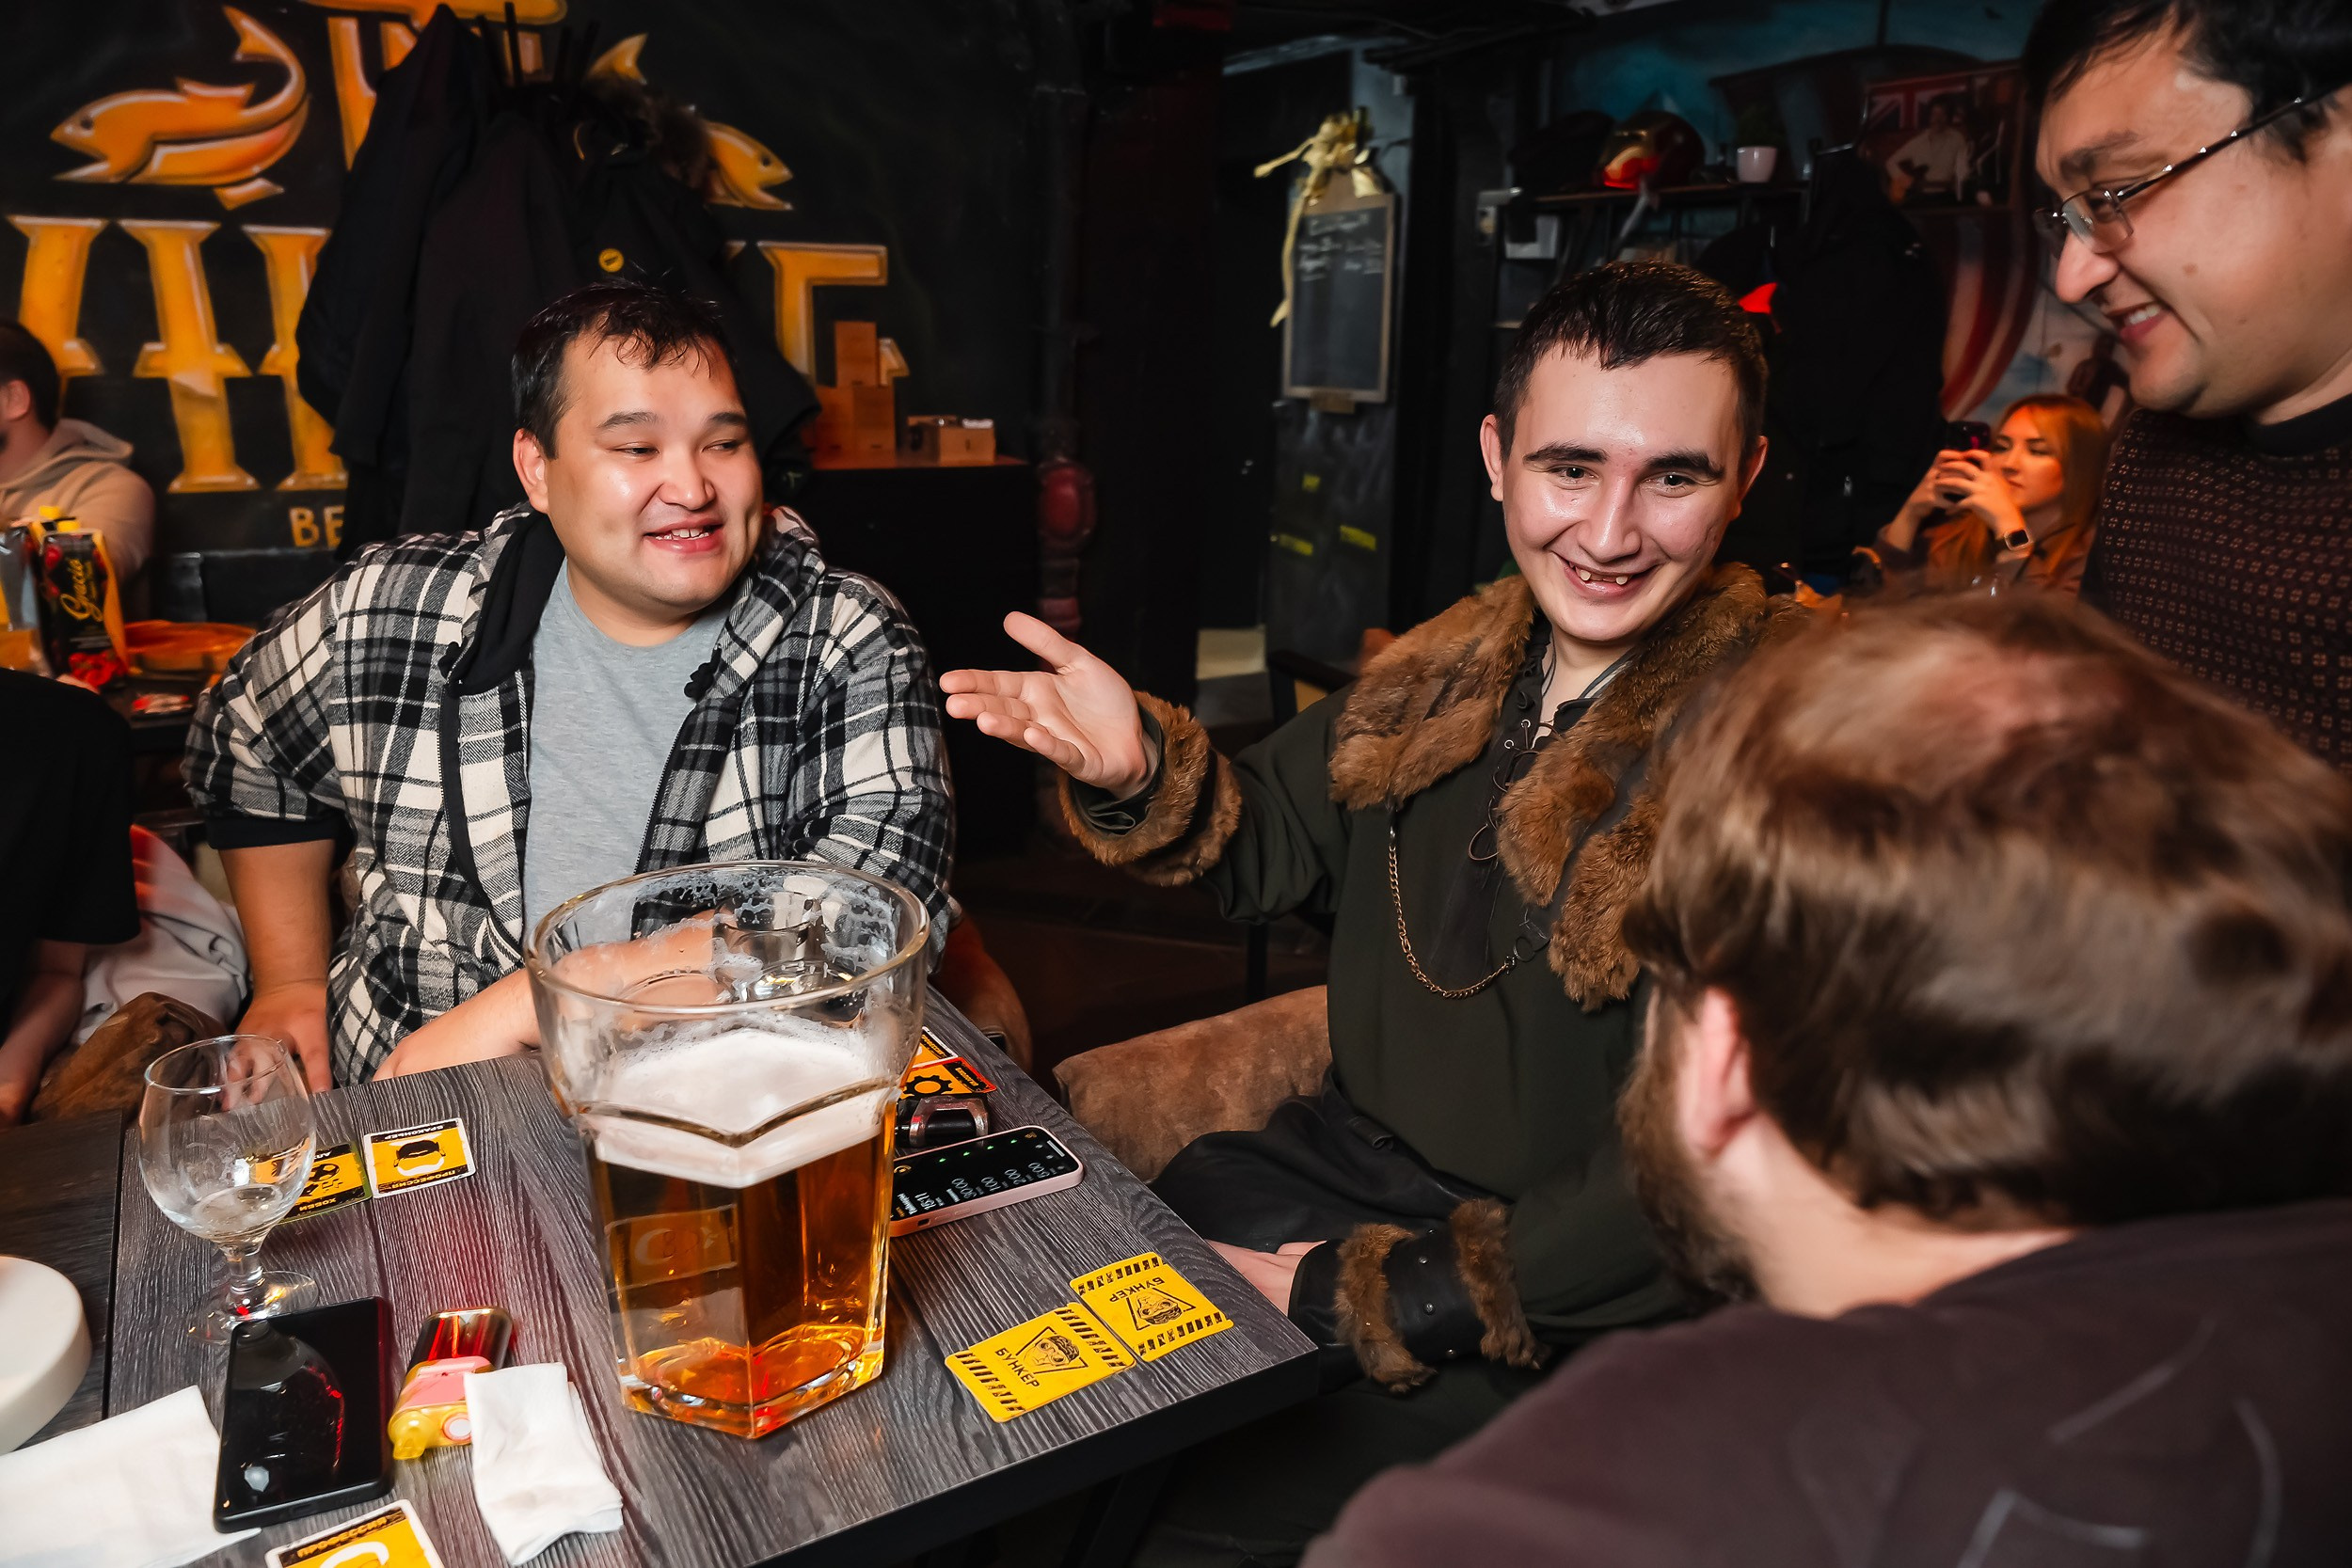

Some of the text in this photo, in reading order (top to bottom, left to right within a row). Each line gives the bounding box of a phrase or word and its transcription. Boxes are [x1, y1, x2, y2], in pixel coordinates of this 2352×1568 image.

[384, 1124, 445, 1140] БРАКОНЬЕР
[390, 1169, 456, 1189] ПРОФЕССИЯ
[299, 1196, 337, 1212] ХОББИ
[1108, 1276, 1165, 1303] БУНКЕР
[994, 1347, 1041, 1388] БУНКЕР
